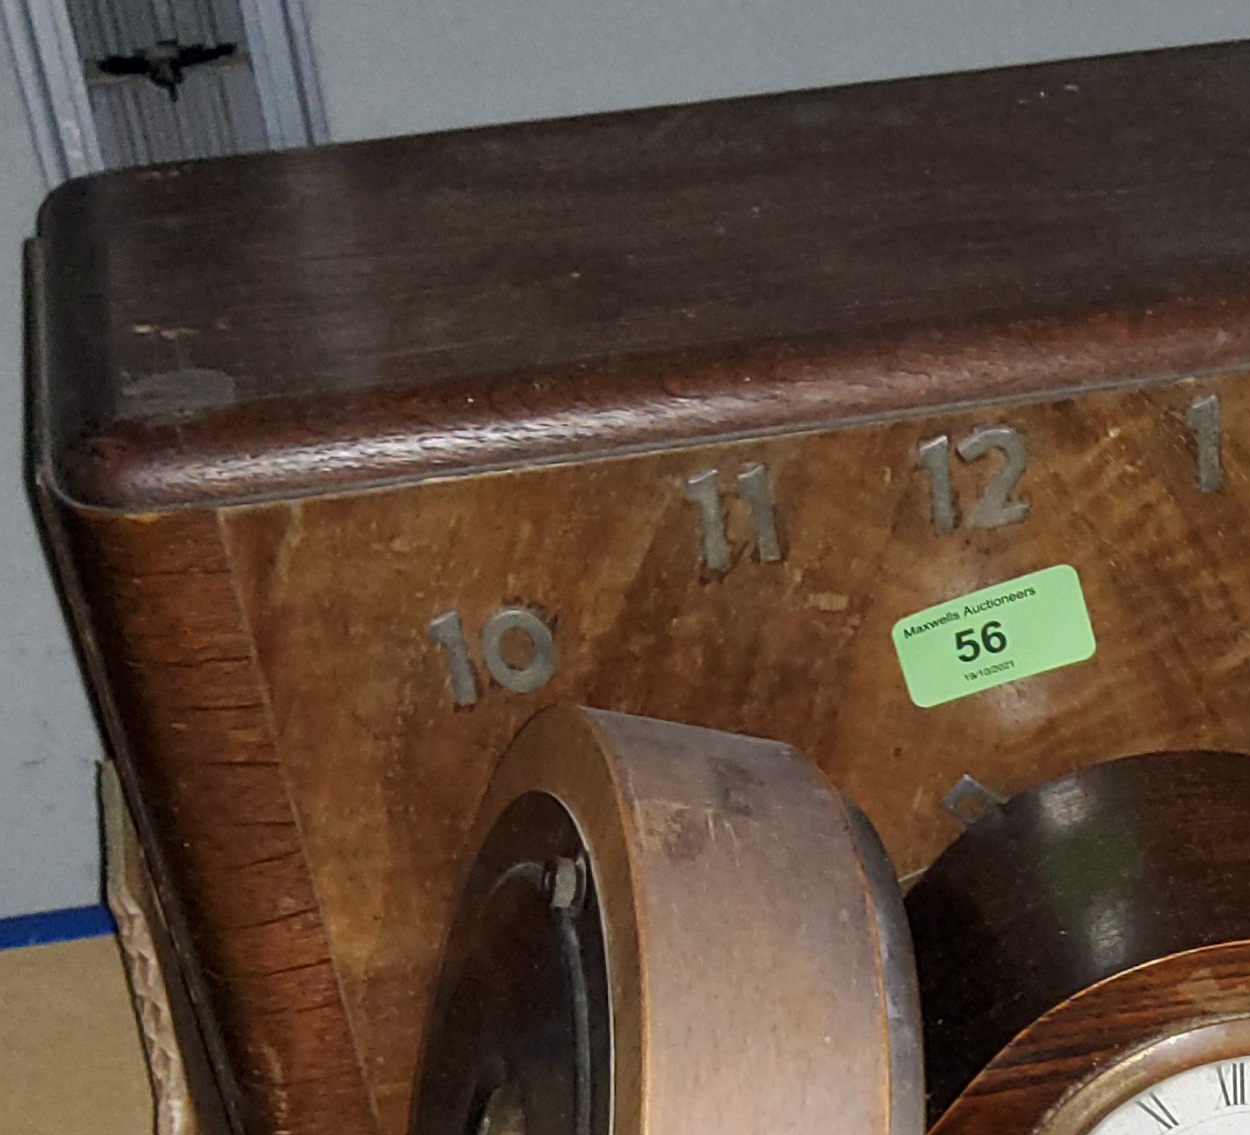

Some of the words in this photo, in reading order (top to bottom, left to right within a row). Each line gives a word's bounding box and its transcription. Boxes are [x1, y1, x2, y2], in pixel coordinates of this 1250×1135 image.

[917, 426, 1030, 534] 12
[1186, 395, 1221, 491] 1
[685, 465, 781, 571] 11
[428, 611, 556, 706] 10
[903, 611, 960, 639] Maxwells
[963, 587, 1036, 616] Auctioneers
[955, 620, 1007, 662] 56
